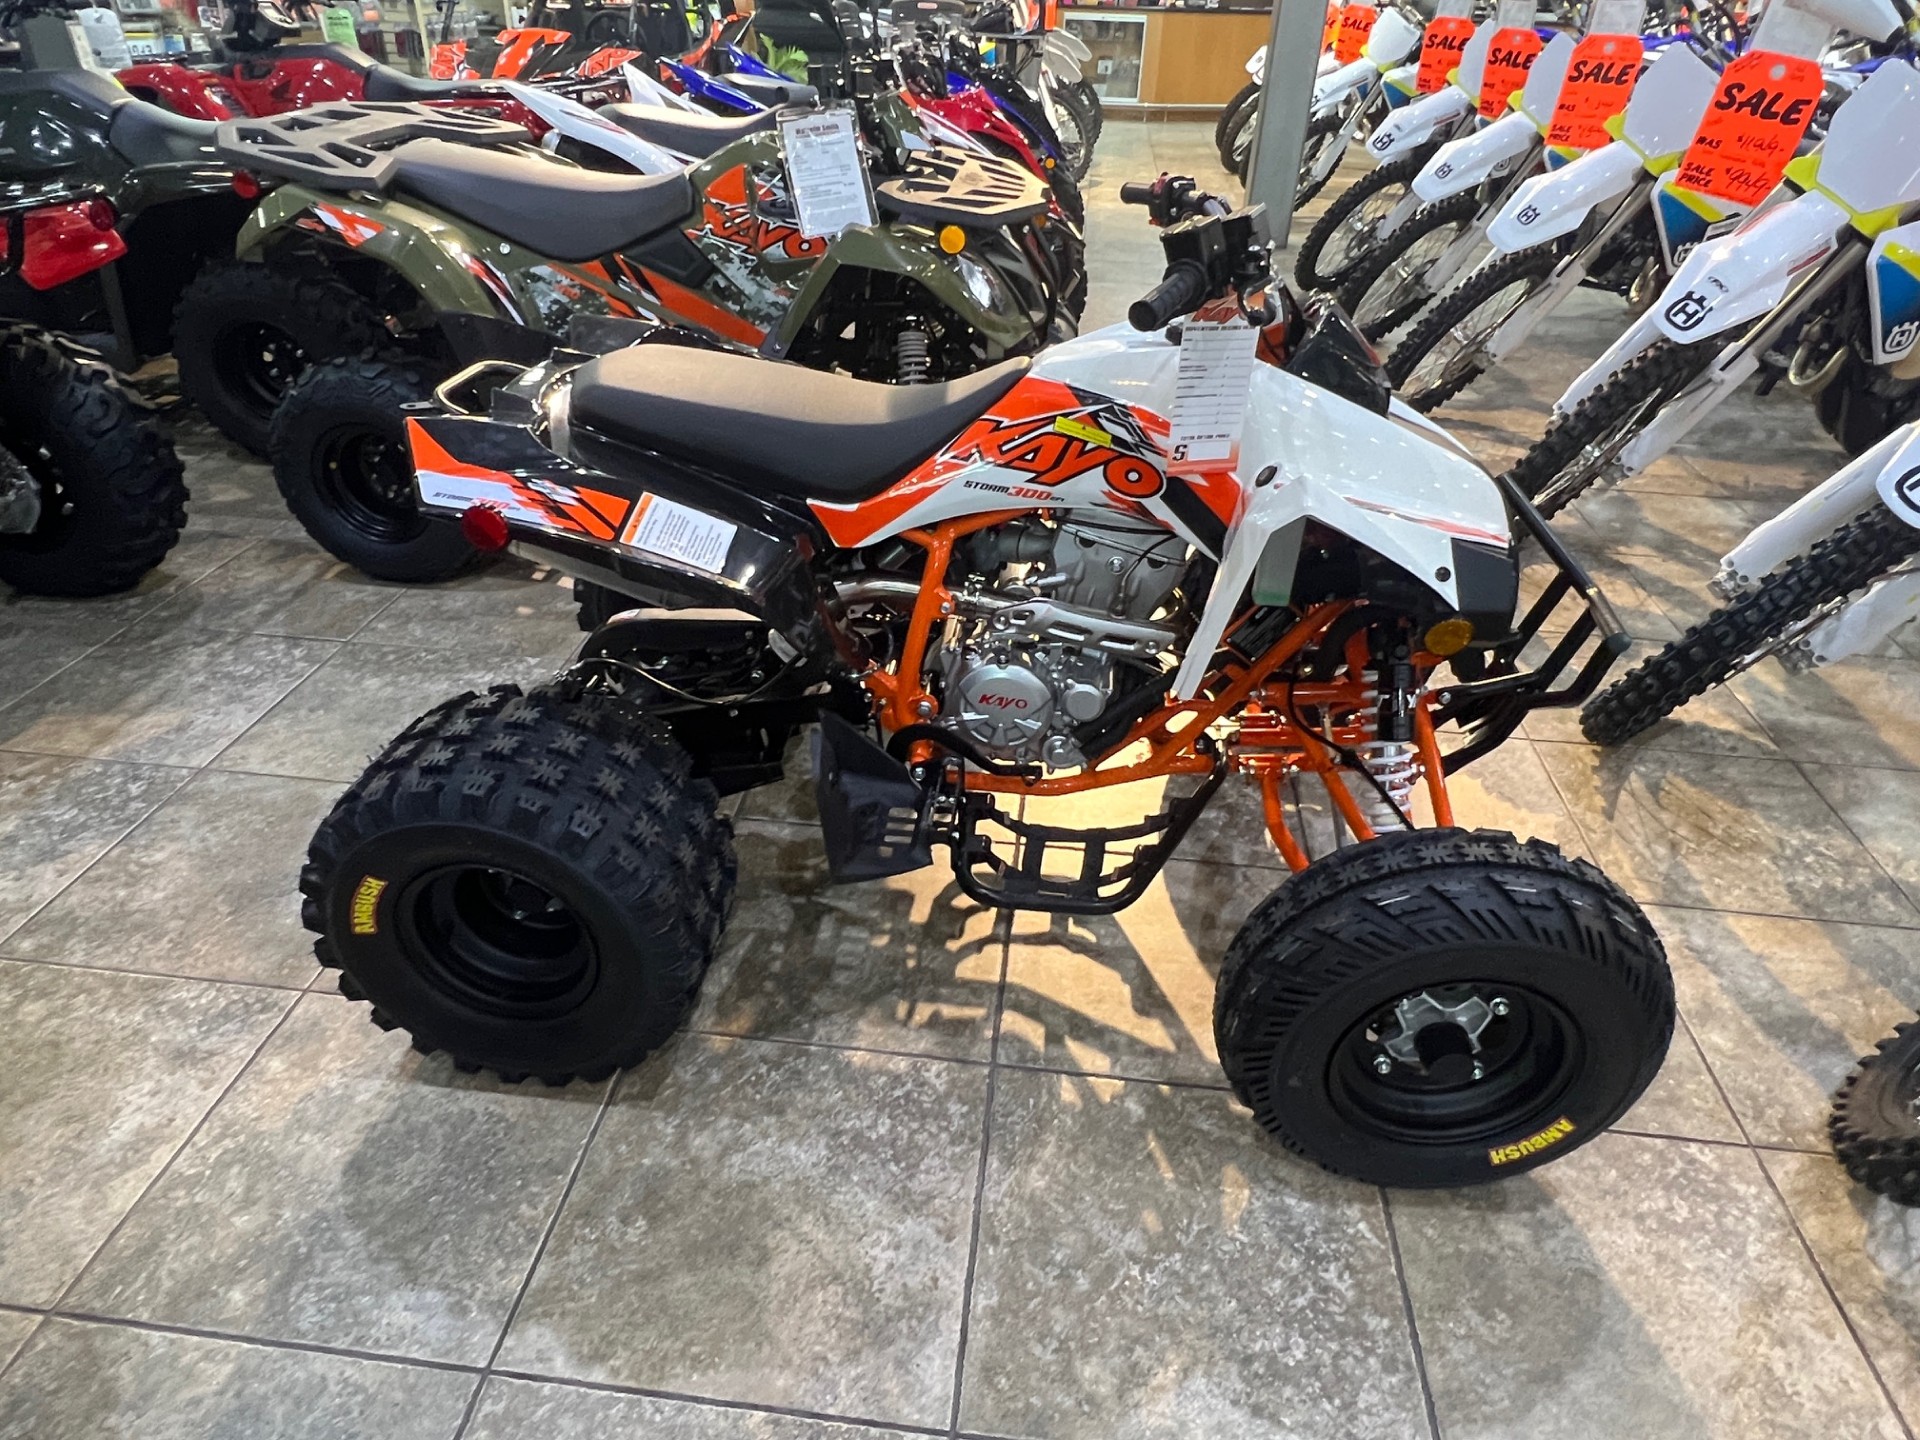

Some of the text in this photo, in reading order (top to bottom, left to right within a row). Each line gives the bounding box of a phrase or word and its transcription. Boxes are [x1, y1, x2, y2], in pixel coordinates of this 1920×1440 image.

[1341, 16, 1373, 33] SALE
[1425, 33, 1471, 52] SALE
[1487, 47, 1539, 71] SALE
[1567, 59, 1636, 86] SALE
[1714, 82, 1813, 126] SALE
[1696, 135, 1722, 150] WAS
[1685, 161, 1715, 177] SALE
[1678, 172, 1713, 188] PRICE
[942, 418, 1165, 499] KAYO
[978, 693, 1028, 710] KAYO
[353, 877, 386, 934] AMBUSH
[1489, 1118, 1576, 1165] AMBUSH
